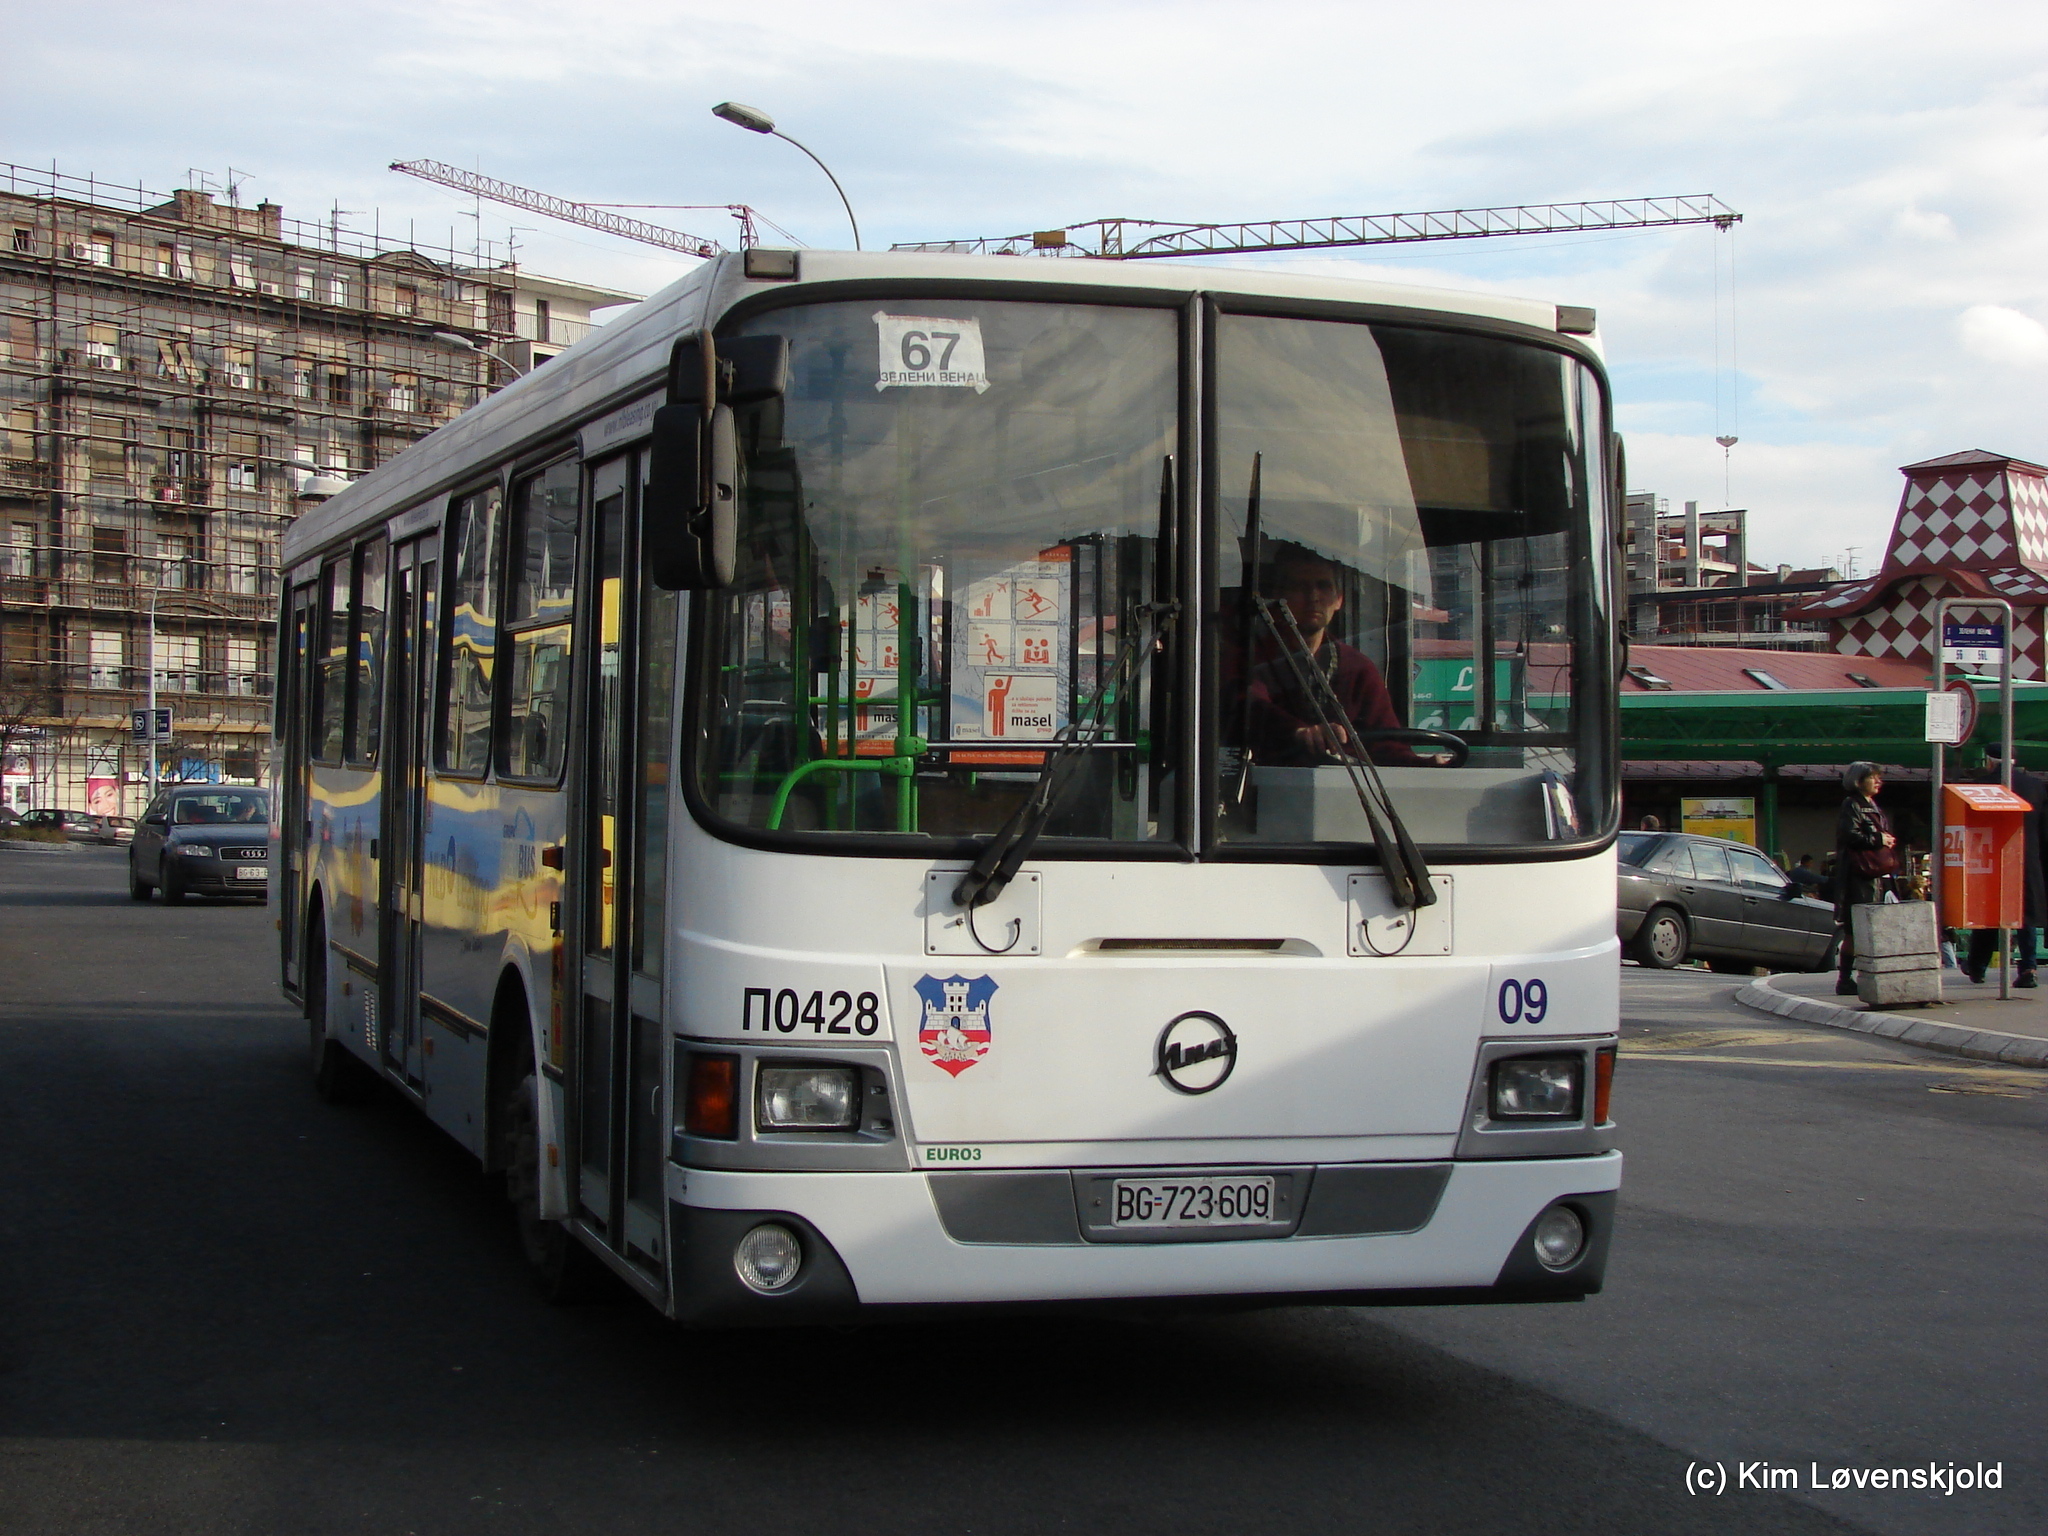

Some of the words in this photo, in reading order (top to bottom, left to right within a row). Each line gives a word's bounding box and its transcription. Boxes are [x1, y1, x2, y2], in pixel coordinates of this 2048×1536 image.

[901, 331, 961, 371] 67
[880, 372, 936, 383] ЗЕЛЕНИ
[873, 713, 898, 723] mas
[1011, 714, 1052, 727] masel
[1498, 978, 1548, 1024] 09
[742, 987, 879, 1036] П0428
[926, 1148, 982, 1161] EURO3
